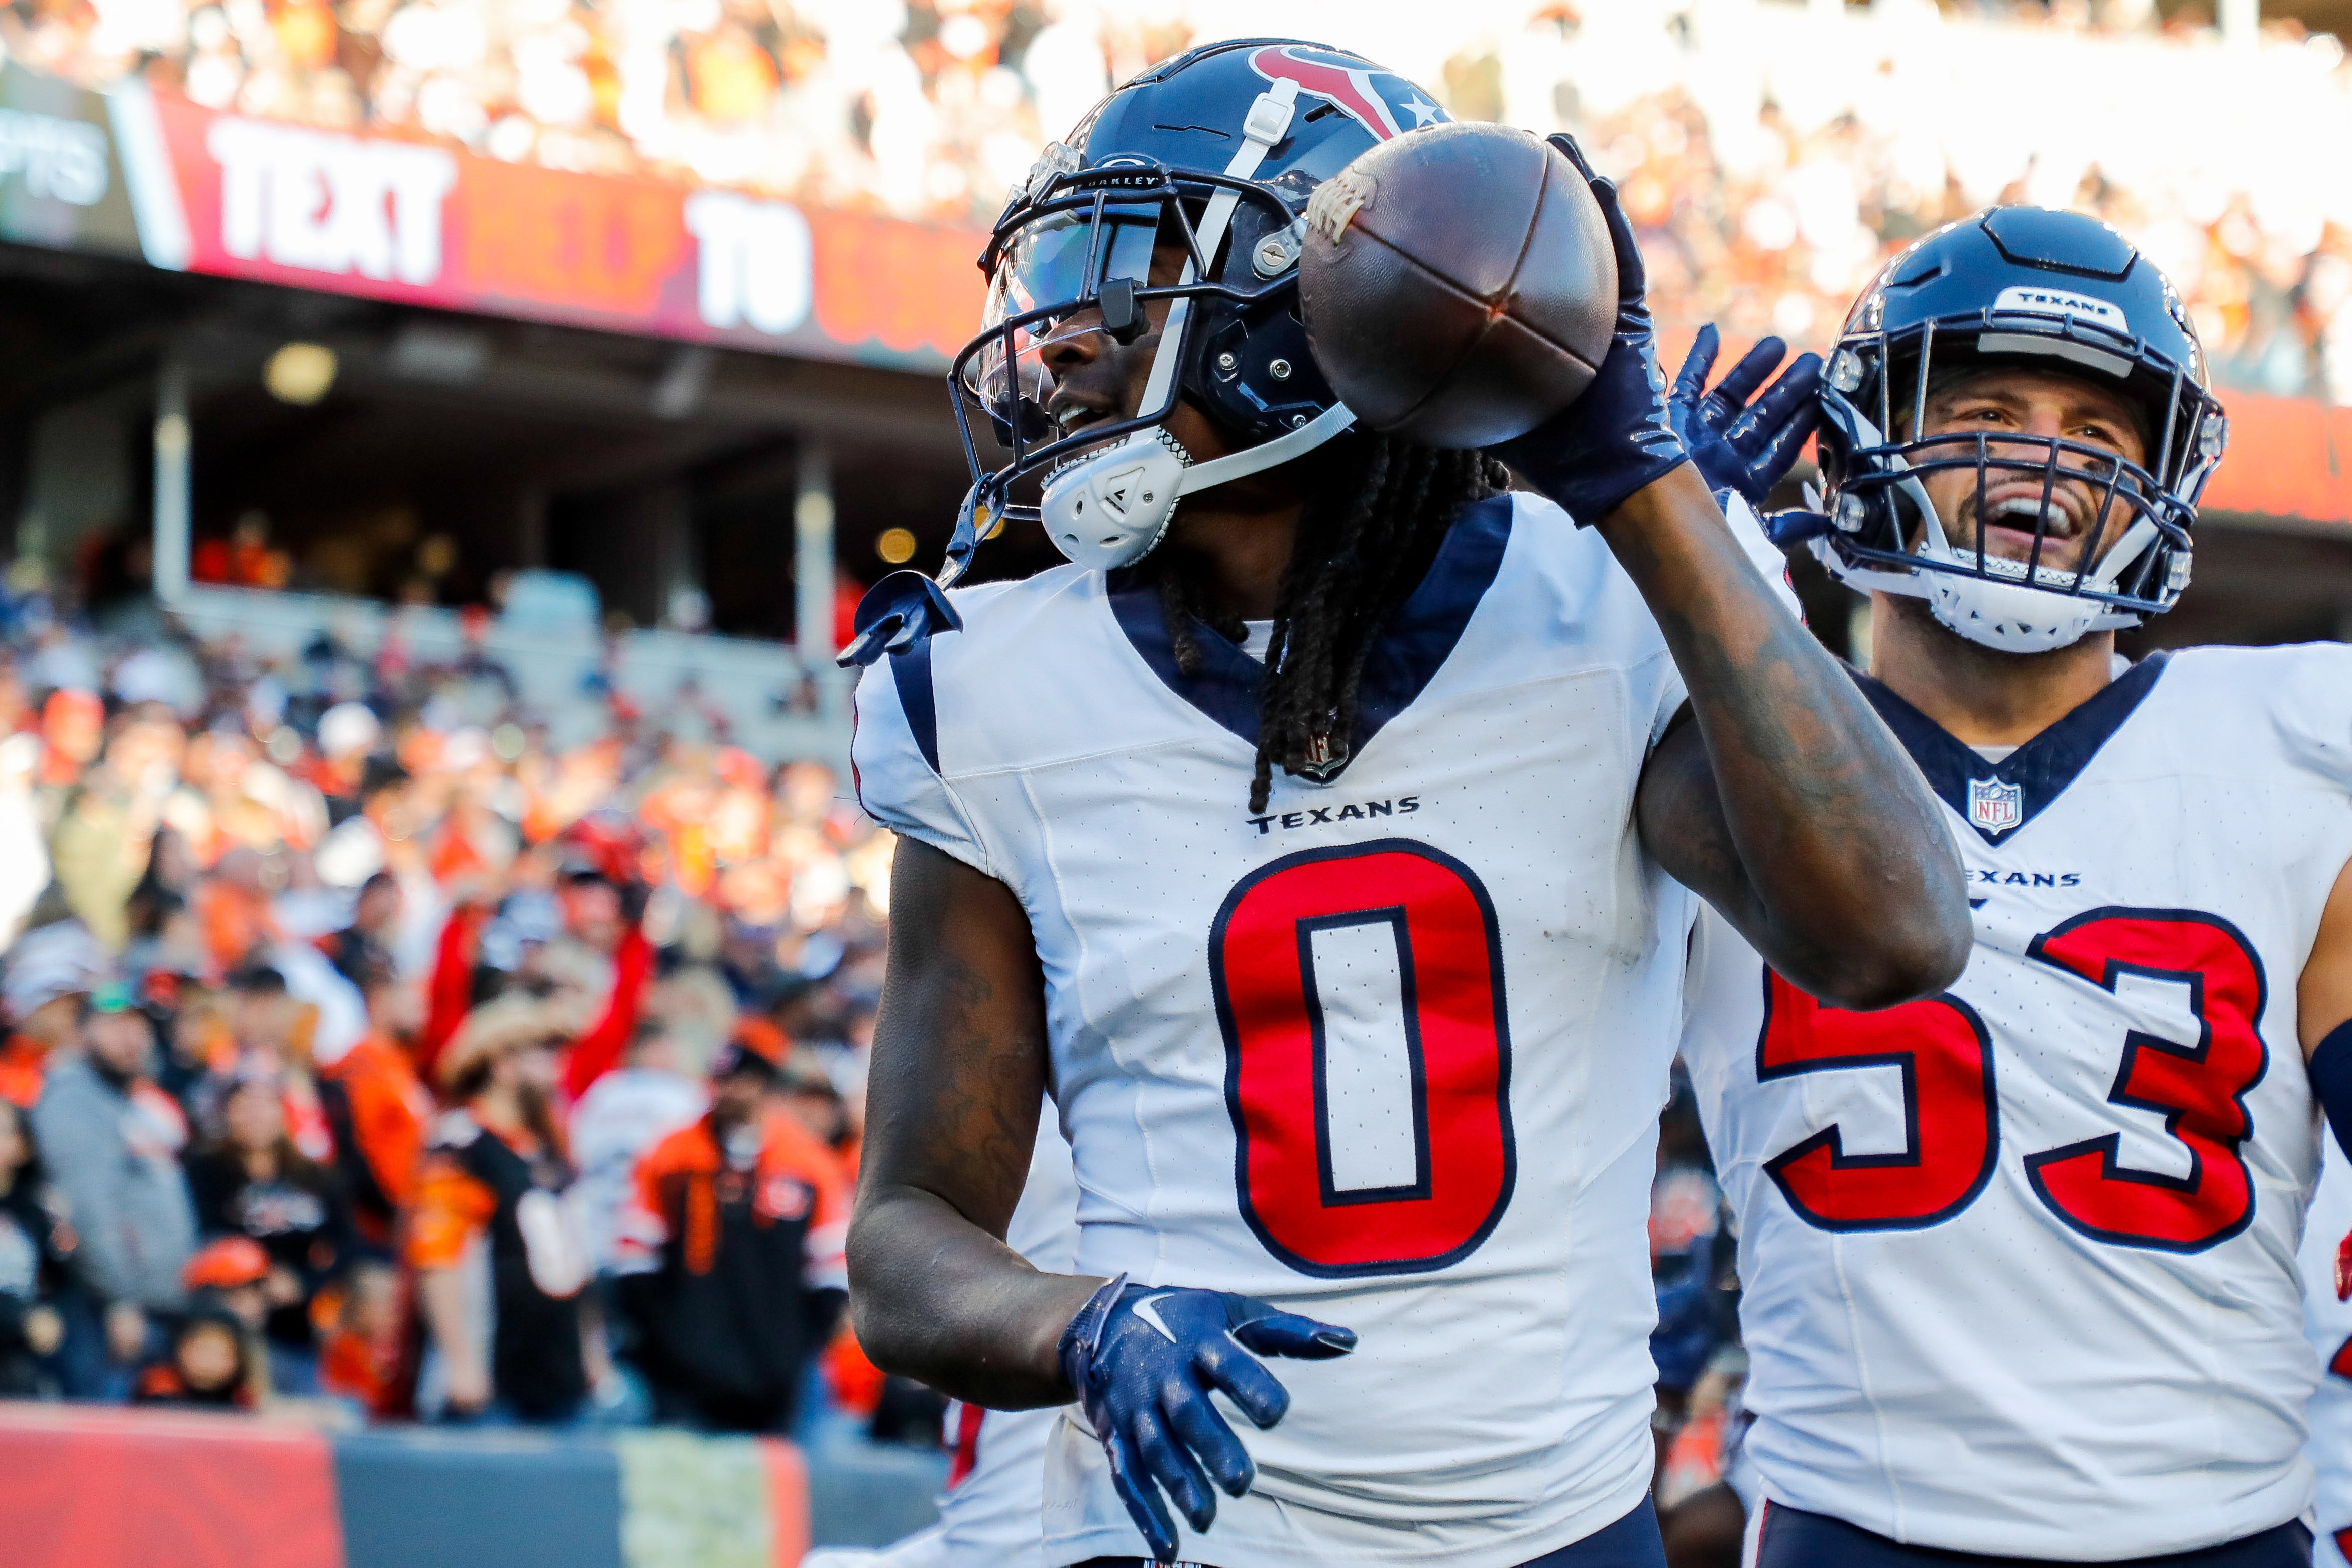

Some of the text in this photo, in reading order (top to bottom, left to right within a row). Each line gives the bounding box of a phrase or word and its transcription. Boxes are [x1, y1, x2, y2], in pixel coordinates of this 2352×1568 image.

[206, 111, 459, 287] TEXT
[682, 190, 814, 335] TO
[2018, 293, 2108, 316] TEXANS
[1246, 795, 1420, 835] TEXANS
[1978, 801, 2014, 822] NFL
[1965, 870, 2082, 887] EXANS
[1207, 837, 1518, 1279] 0
[1756, 899, 2267, 1256] 53
